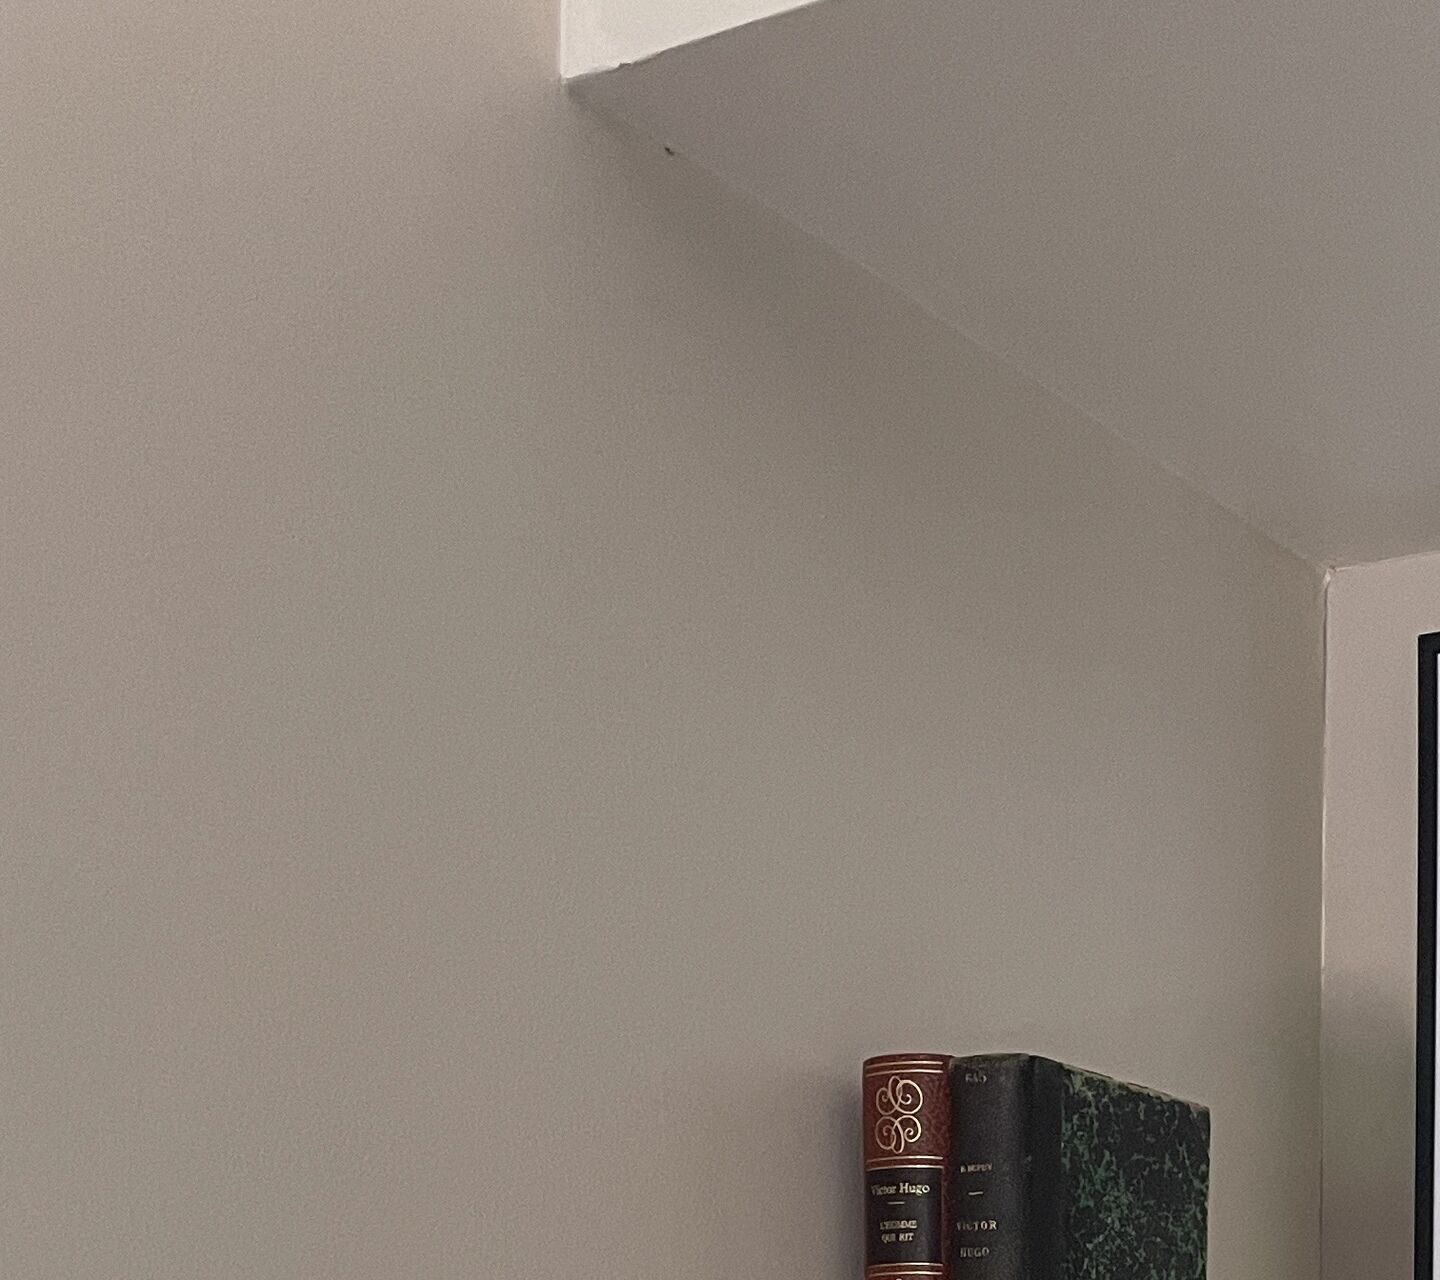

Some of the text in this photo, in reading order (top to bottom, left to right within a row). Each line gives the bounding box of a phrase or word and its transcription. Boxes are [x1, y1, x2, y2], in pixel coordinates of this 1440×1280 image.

[900, 1183, 930, 1196] Hugo
[957, 1219, 998, 1231] VICTOR
[960, 1247, 989, 1257] HUGO
